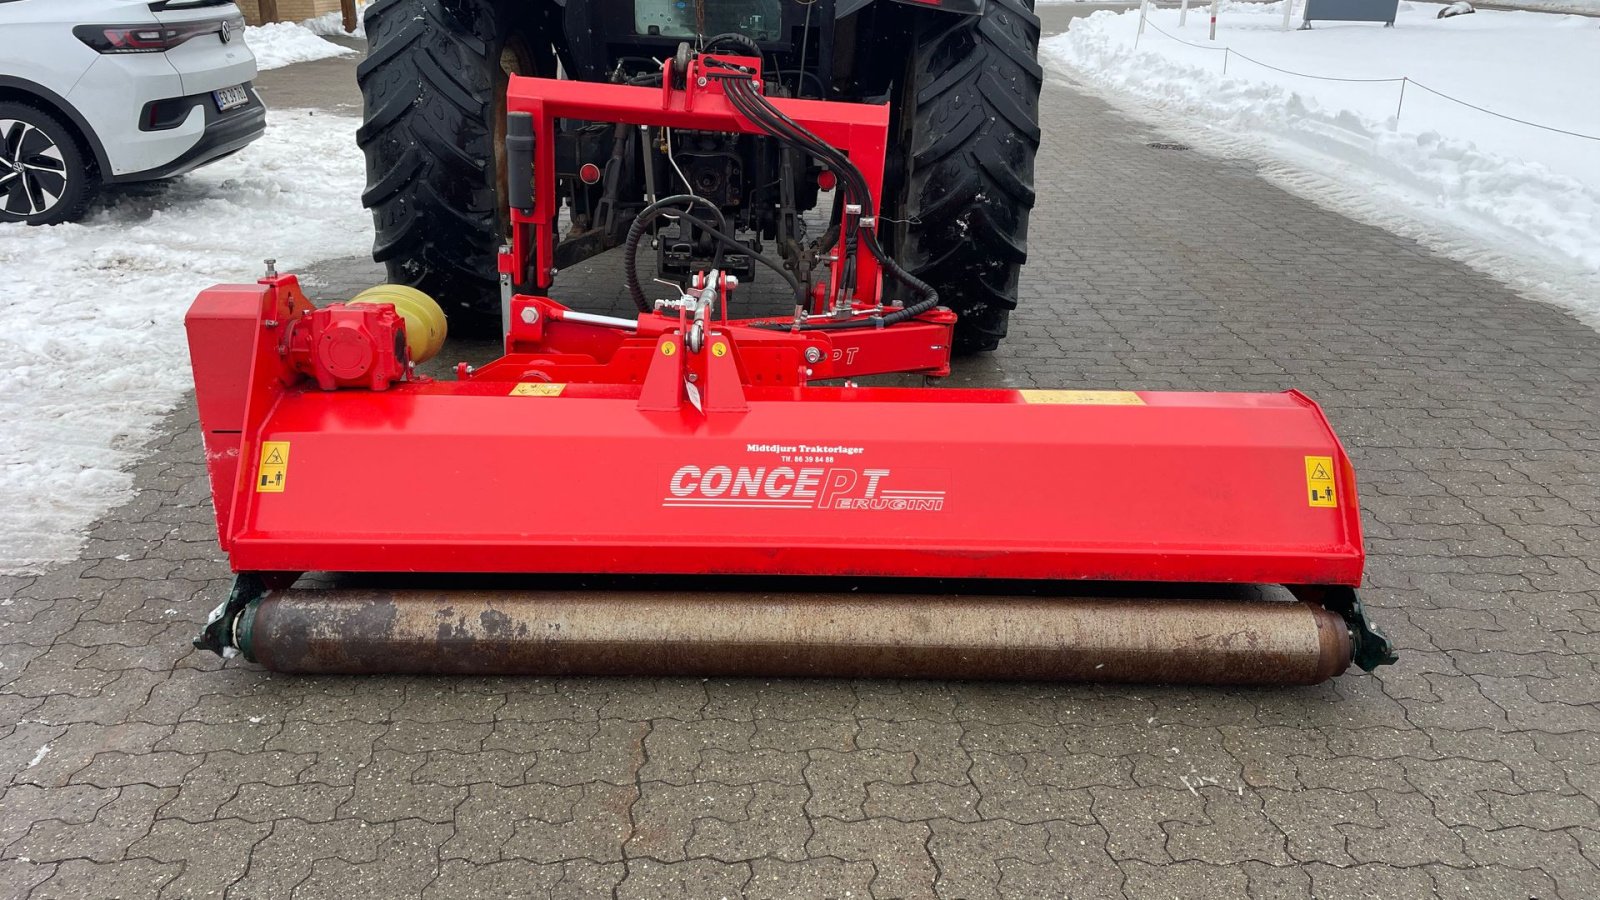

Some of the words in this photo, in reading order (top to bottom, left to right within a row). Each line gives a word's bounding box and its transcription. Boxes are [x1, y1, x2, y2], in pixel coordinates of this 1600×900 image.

[747, 444, 797, 454] Midtdjurs
[798, 445, 864, 455] Traktorlager
[794, 455, 803, 463] 86
[669, 465, 890, 508] CONCEPT
